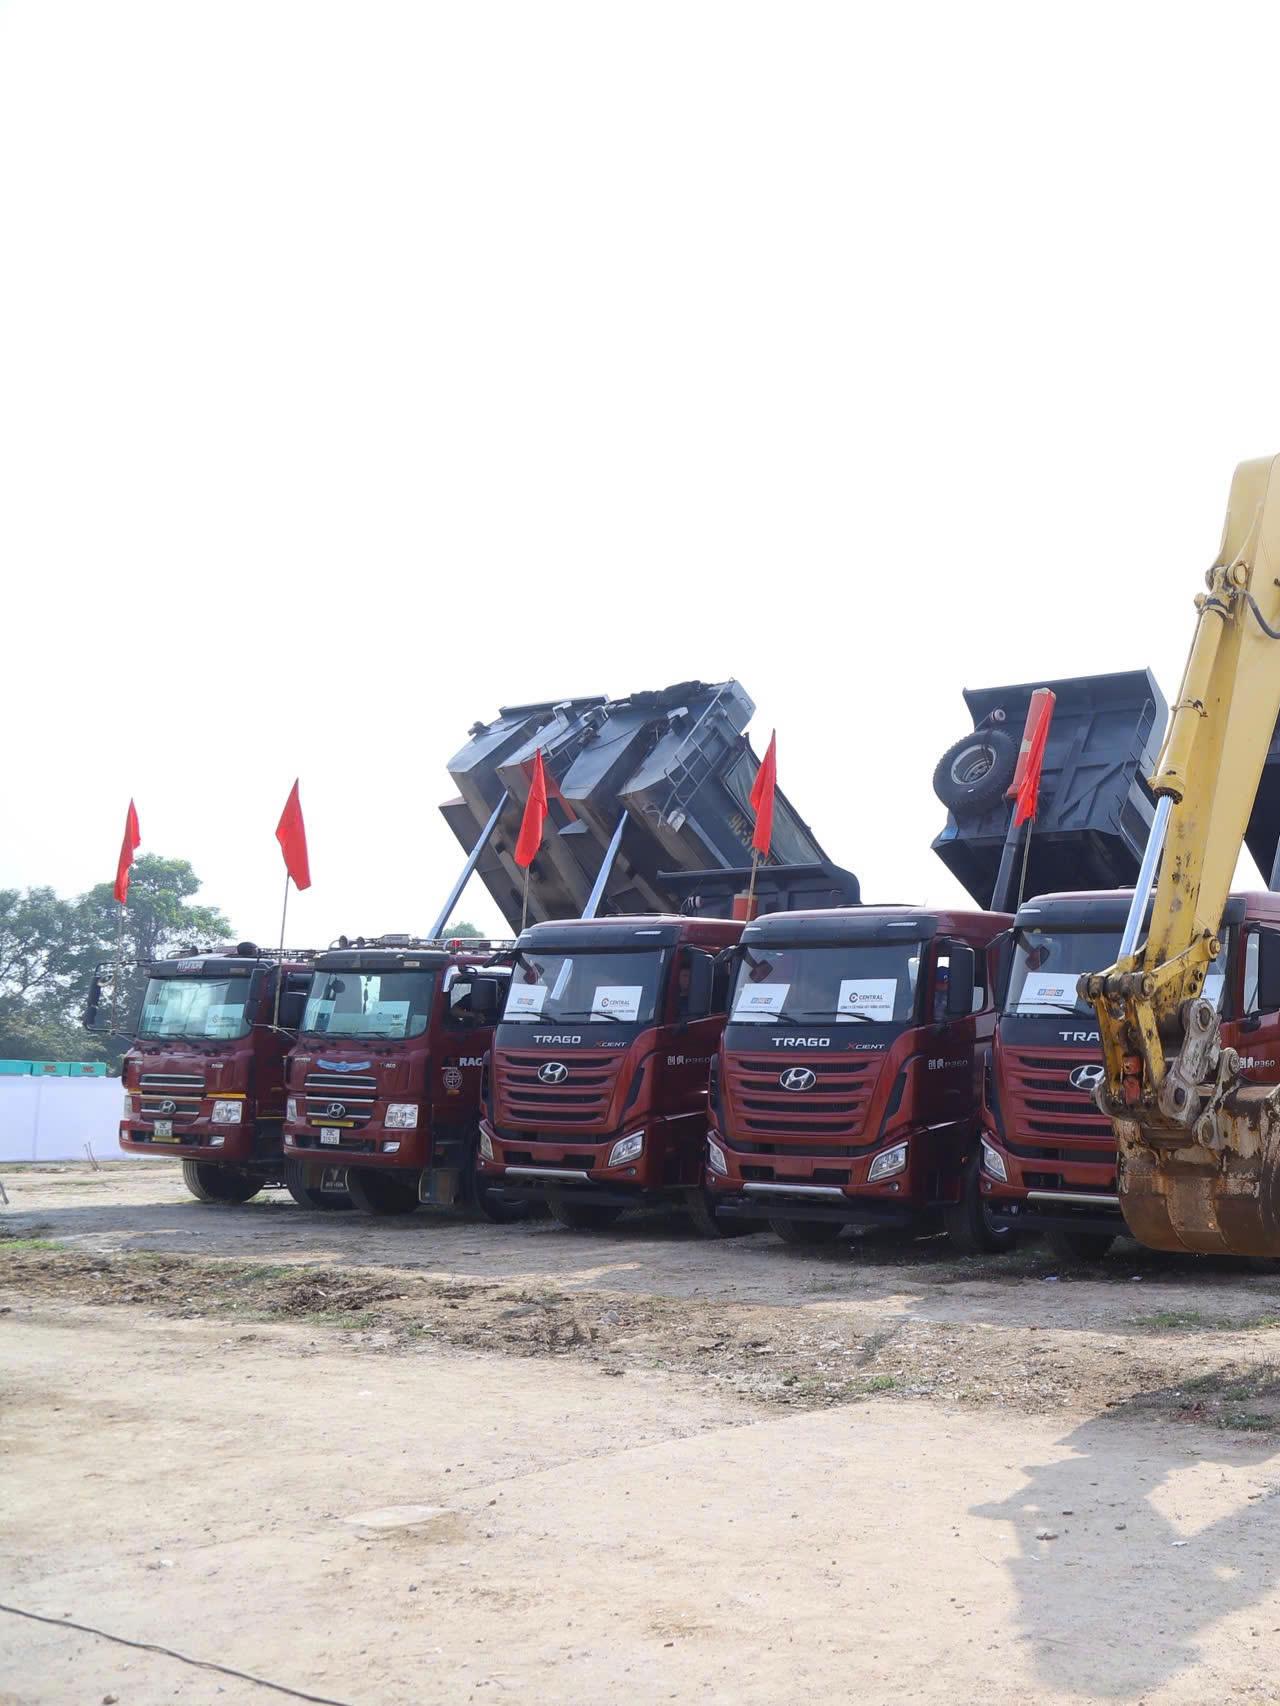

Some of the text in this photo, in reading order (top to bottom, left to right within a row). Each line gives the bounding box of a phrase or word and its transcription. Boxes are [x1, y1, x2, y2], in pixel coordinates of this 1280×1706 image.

[533, 1035, 582, 1044] TRAGO
[1059, 1031, 1100, 1042] TRA
[772, 1037, 831, 1047] TRAGO
[459, 1057, 482, 1067] RAG
